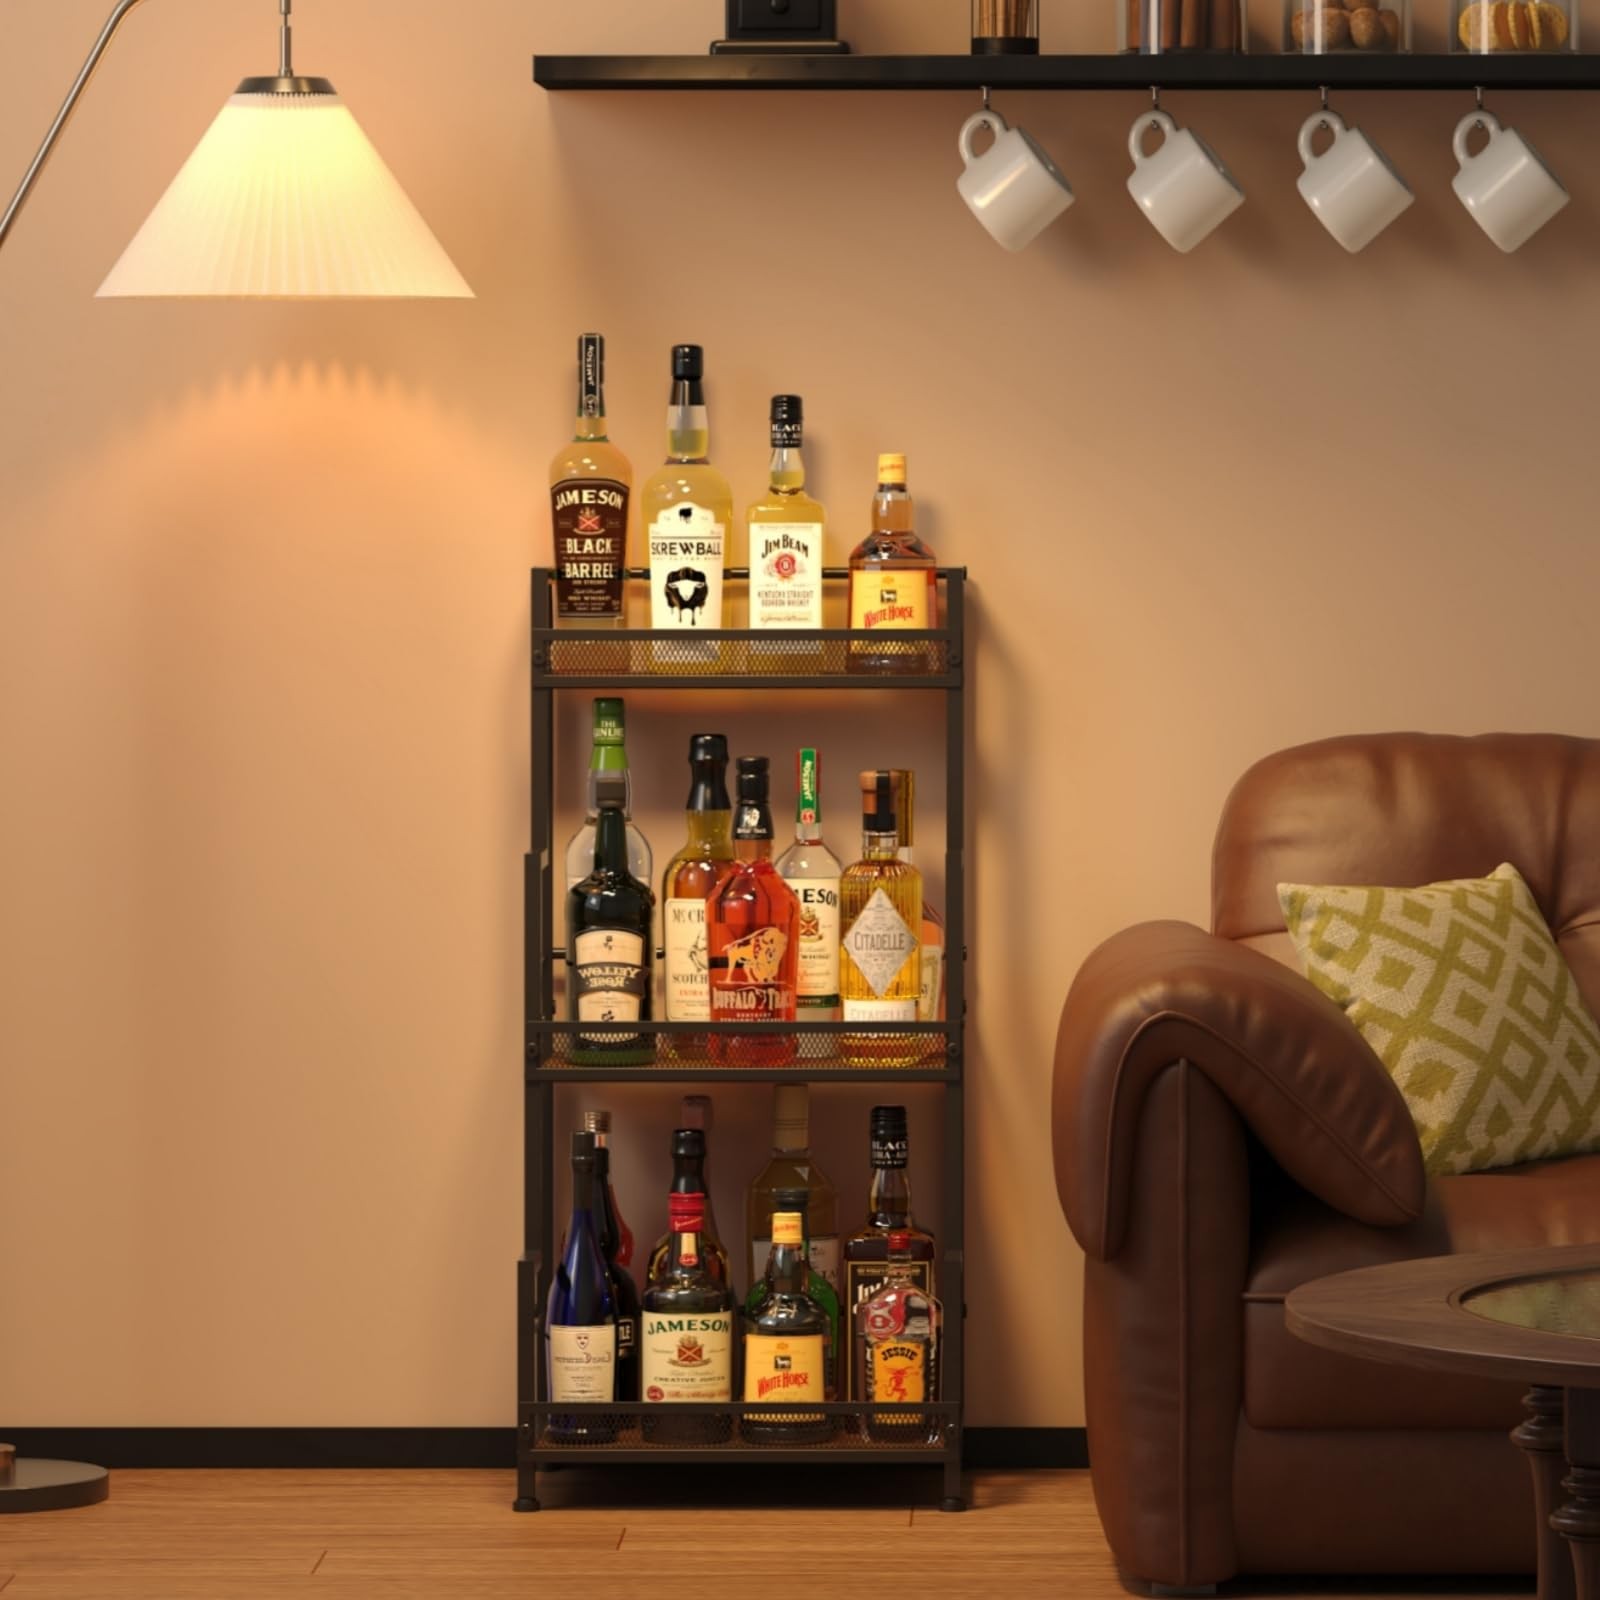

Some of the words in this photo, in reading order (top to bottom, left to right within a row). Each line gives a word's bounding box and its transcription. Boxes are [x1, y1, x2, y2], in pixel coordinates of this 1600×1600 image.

[555, 489, 624, 511] JAMESON
[566, 538, 613, 554] BLACK
[761, 539, 780, 559] JIM
[782, 534, 809, 558] BEAM
[565, 562, 614, 579] BARREL
[864, 608, 887, 629] WHITE
[888, 605, 915, 622] HORSE
[795, 889, 838, 908] ESON
[855, 932, 905, 950] CITADELLE
[648, 1319, 729, 1335] JAMESON
[881, 1346, 918, 1361] JESSIE
[757, 1376, 781, 1398] WHITE
[782, 1371, 808, 1389] HORSE
